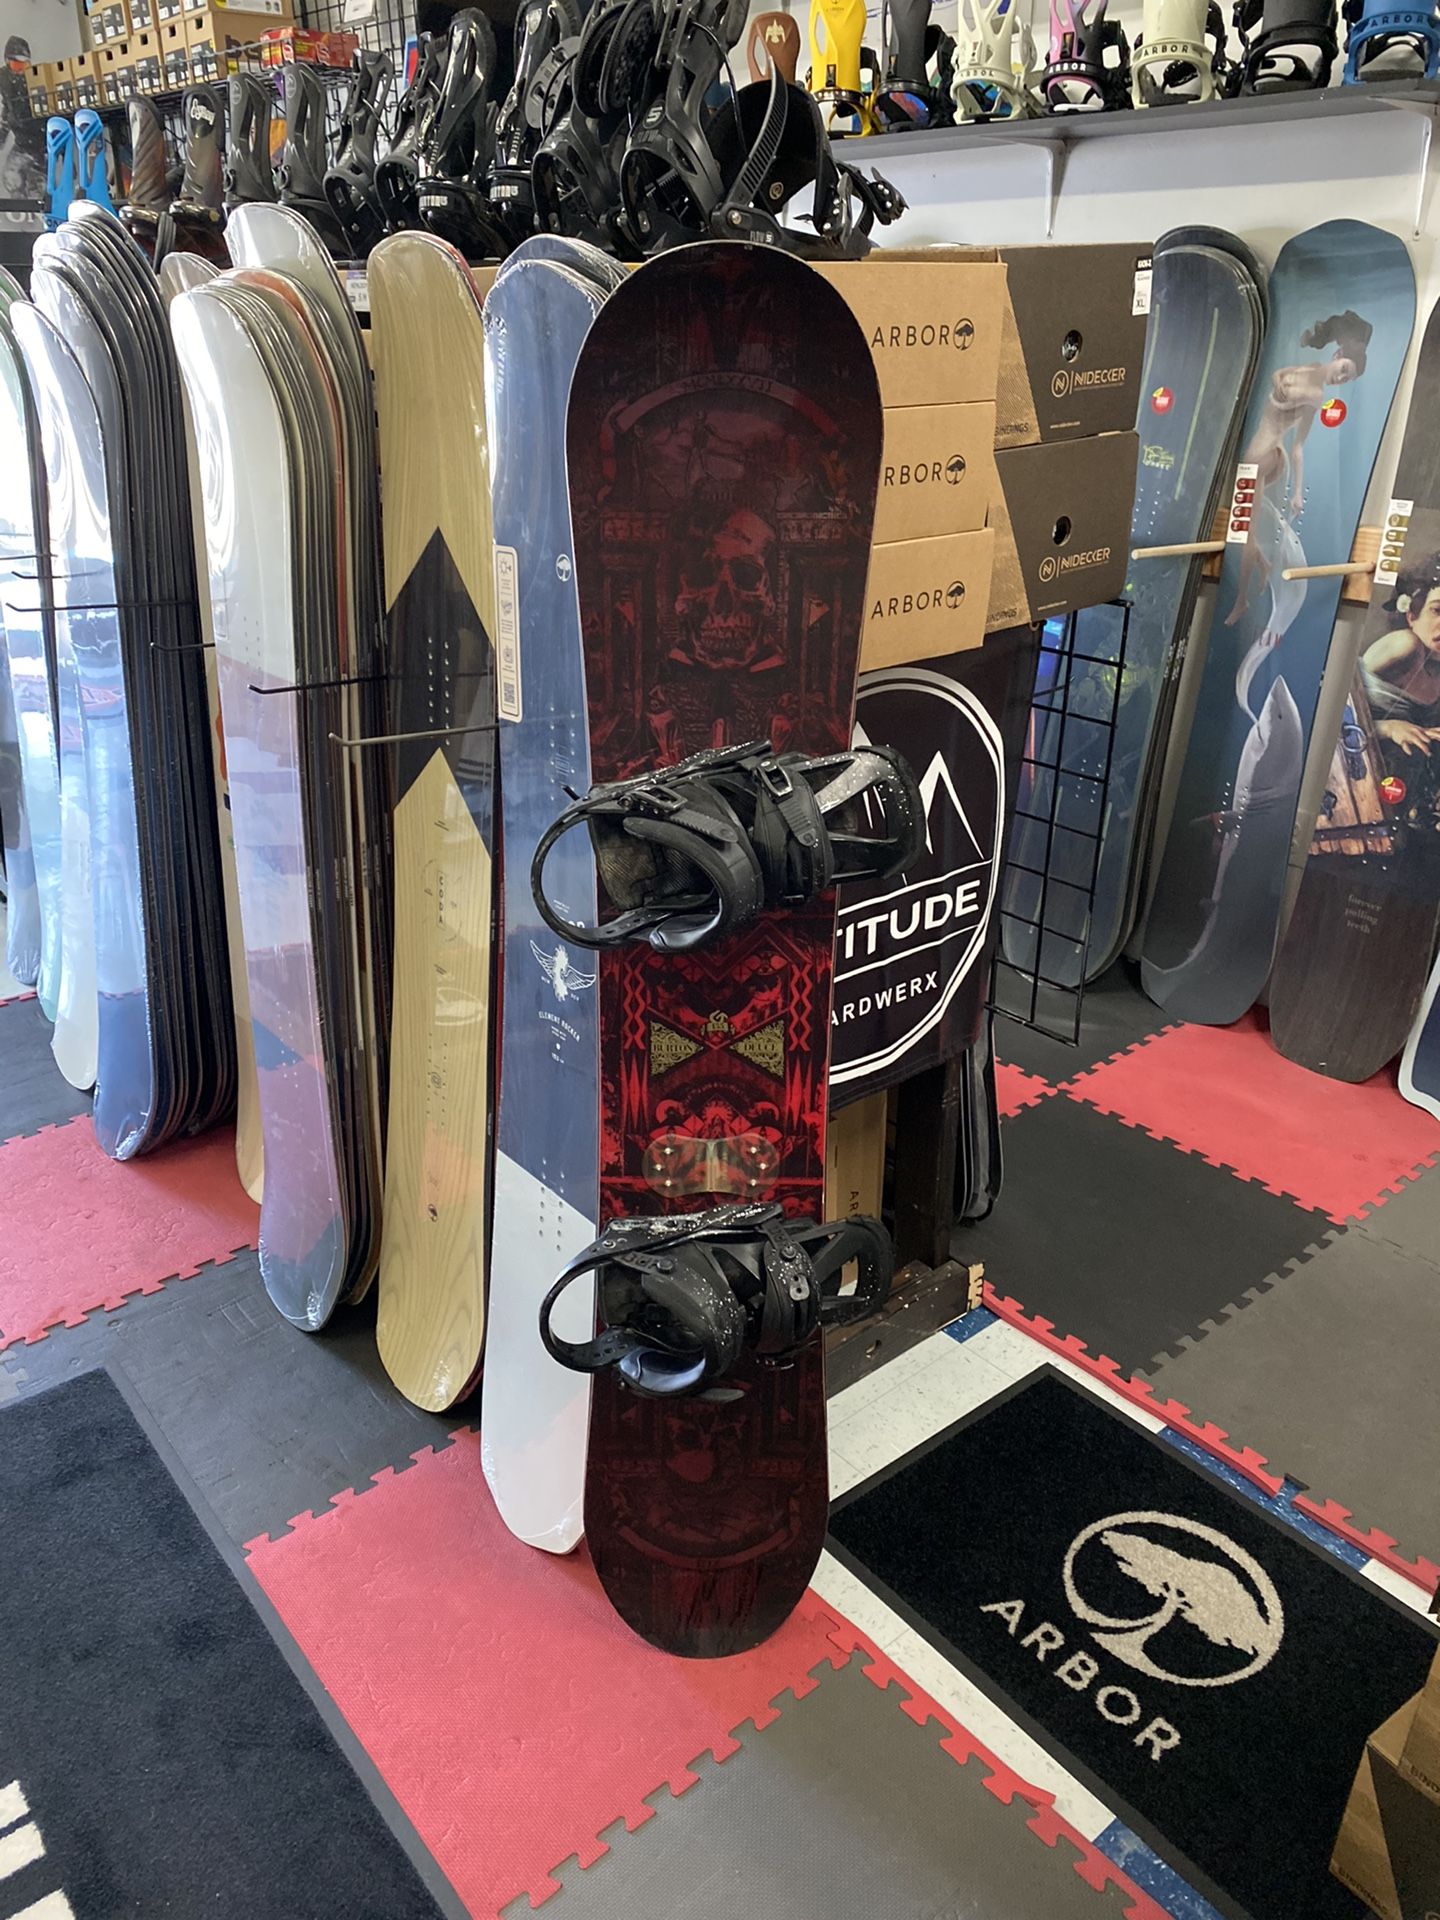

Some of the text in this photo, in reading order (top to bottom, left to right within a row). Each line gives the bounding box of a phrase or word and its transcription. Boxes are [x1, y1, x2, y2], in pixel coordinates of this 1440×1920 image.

[1144, 44, 1190, 57] ARBOR
[871, 323, 951, 349] ARBOR
[1074, 367, 1126, 387] NIDECKER
[1060, 547, 1111, 569] NIDECKER
[871, 588, 943, 620] ARBOR
[437, 875, 445, 925] CODA
[653, 1043, 693, 1053] BURTON
[849, 1191, 860, 1218] AR
[979, 1598, 1182, 1763] ARBOR
